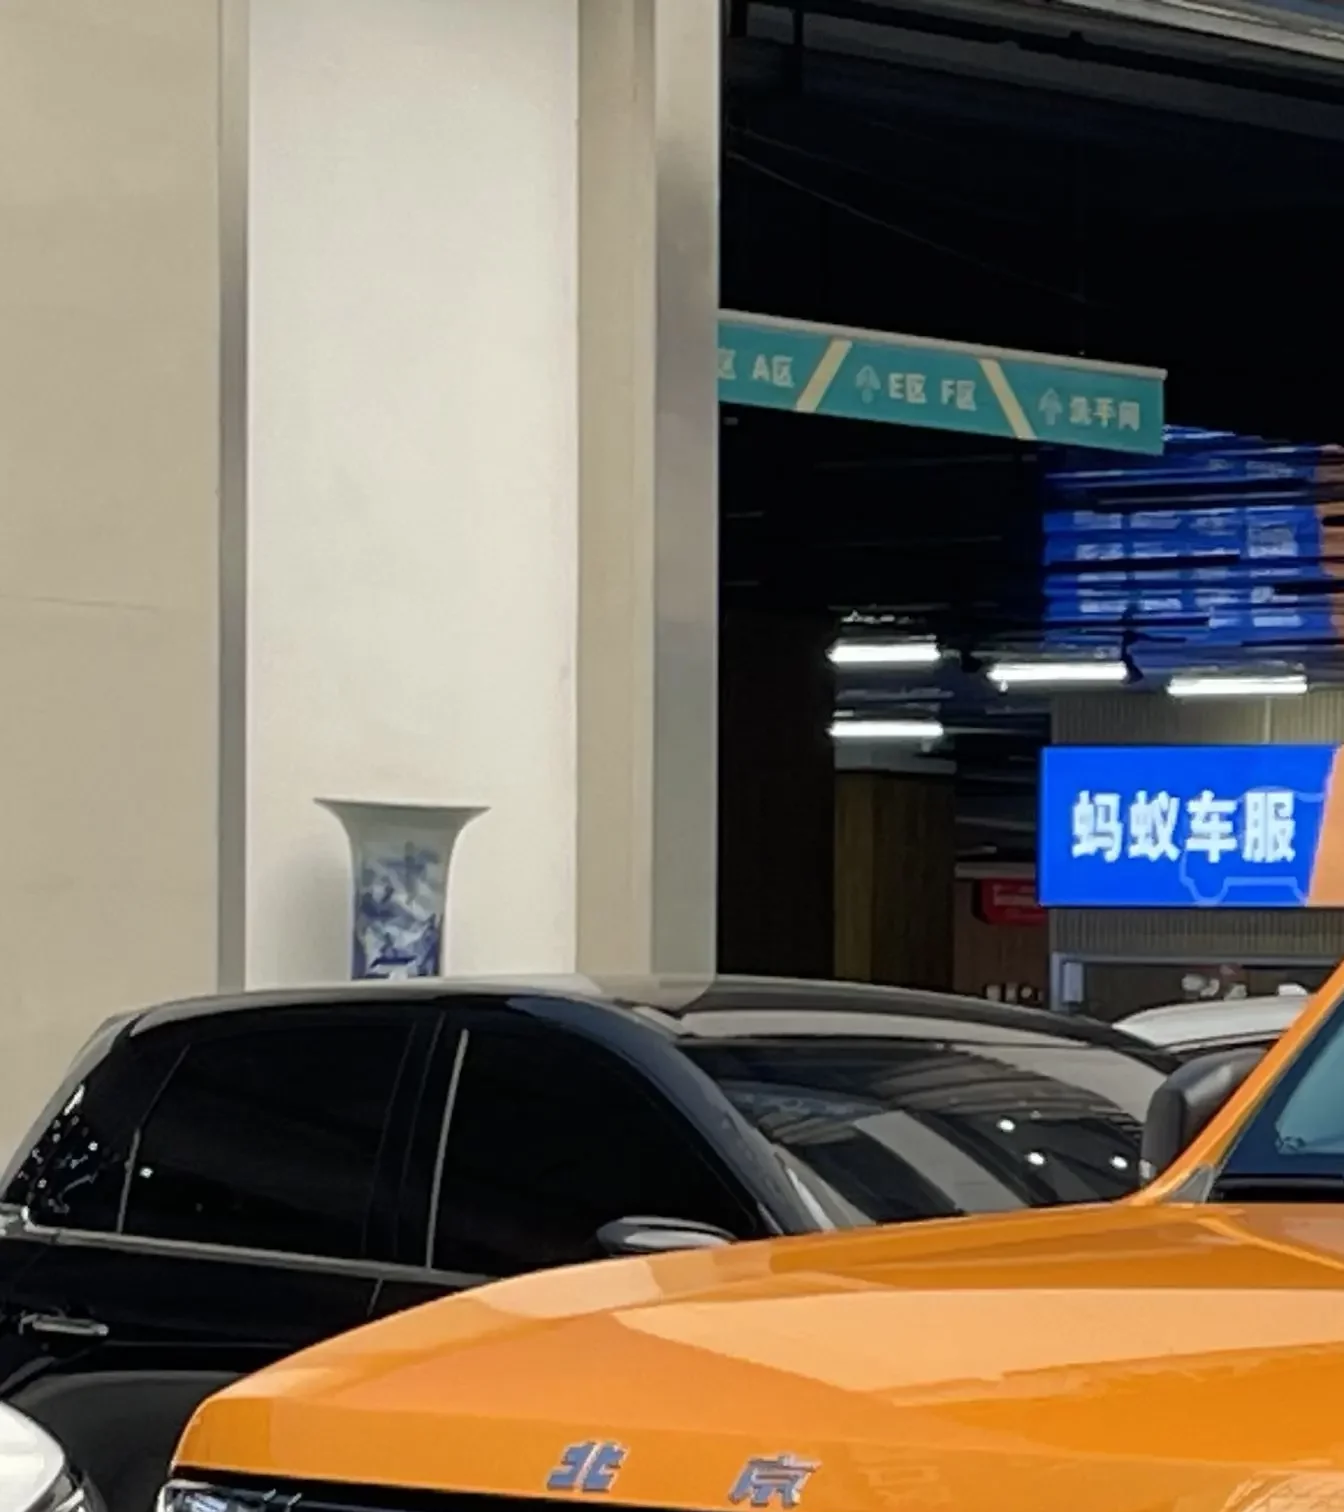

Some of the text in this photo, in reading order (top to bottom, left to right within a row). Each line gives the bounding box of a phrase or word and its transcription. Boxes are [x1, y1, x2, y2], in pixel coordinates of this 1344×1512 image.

[1071, 789, 1297, 863] 蚂蚁车服
[546, 1439, 823, 1509] 北京
